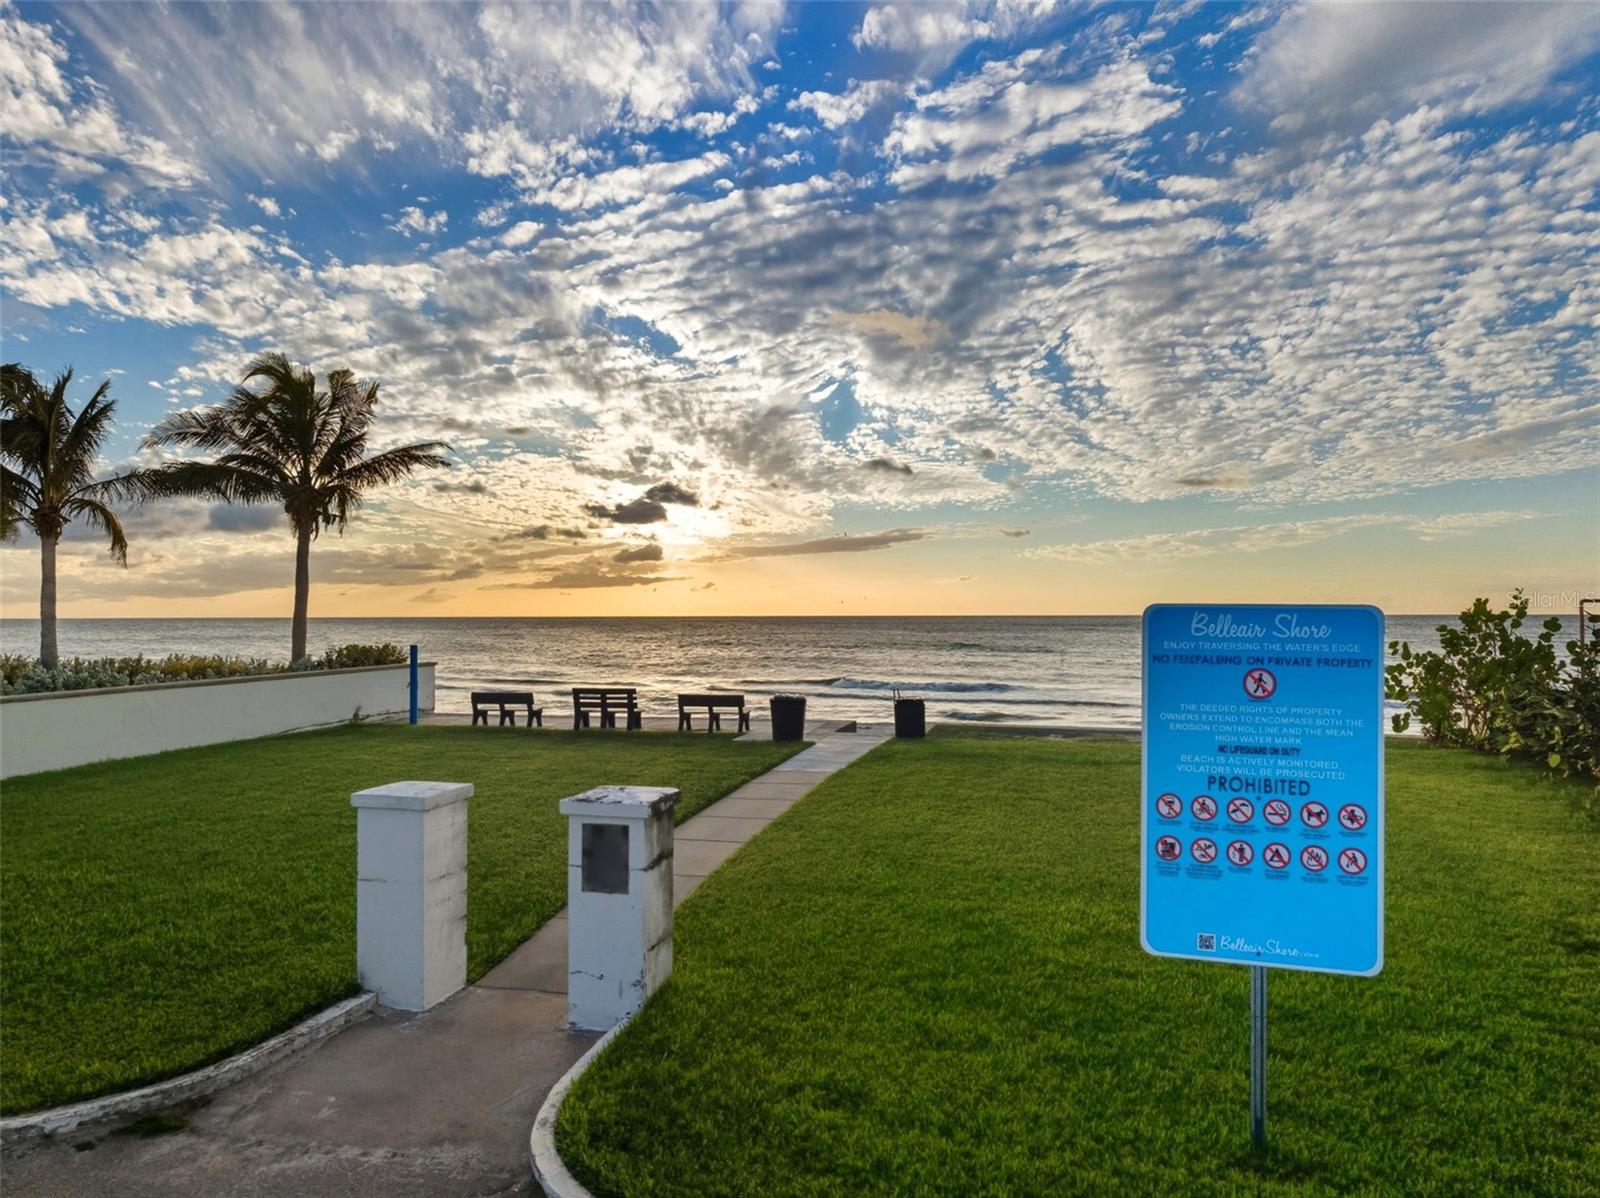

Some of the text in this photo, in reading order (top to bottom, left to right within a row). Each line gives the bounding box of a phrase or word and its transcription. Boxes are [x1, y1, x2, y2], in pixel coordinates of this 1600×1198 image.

[1191, 612, 1331, 639] Belleair Shore
[1164, 641, 1360, 652] ENJOY TRAVERSING THE WATER'S EDGE
[1153, 655, 1169, 664] NO
[1247, 657, 1265, 665] ON
[1180, 703, 1197, 711] THE
[1200, 704, 1237, 713] DEEDED
[1239, 706, 1273, 714] RIGHTS
[1291, 707, 1342, 716] PROPERTY
[1160, 713, 1364, 727] OWNERS EXTEND TO ENCOMPASS BOTH THE
[1170, 722, 1210, 731] EROSION
[1212, 724, 1257, 733] CONTROL
[1259, 726, 1280, 734] LINE
[1282, 727, 1302, 735] AND
[1325, 728, 1353, 736] MEAN
[1239, 735, 1273, 743] WATER
[1275, 736, 1302, 744] MARK
[1230, 746, 1269, 755] LIFEGUARD
[1271, 747, 1280, 755] ON
[1281, 747, 1301, 756] DUTY
[1181, 754, 1214, 763] BEACH
[1216, 756, 1226, 764] IS
[1228, 756, 1275, 766] ACTIVELY
[1177, 764, 1345, 780] VIOLATORS WILL BE PROSECUTED
[1208, 776, 1310, 795] PROHIBITED
